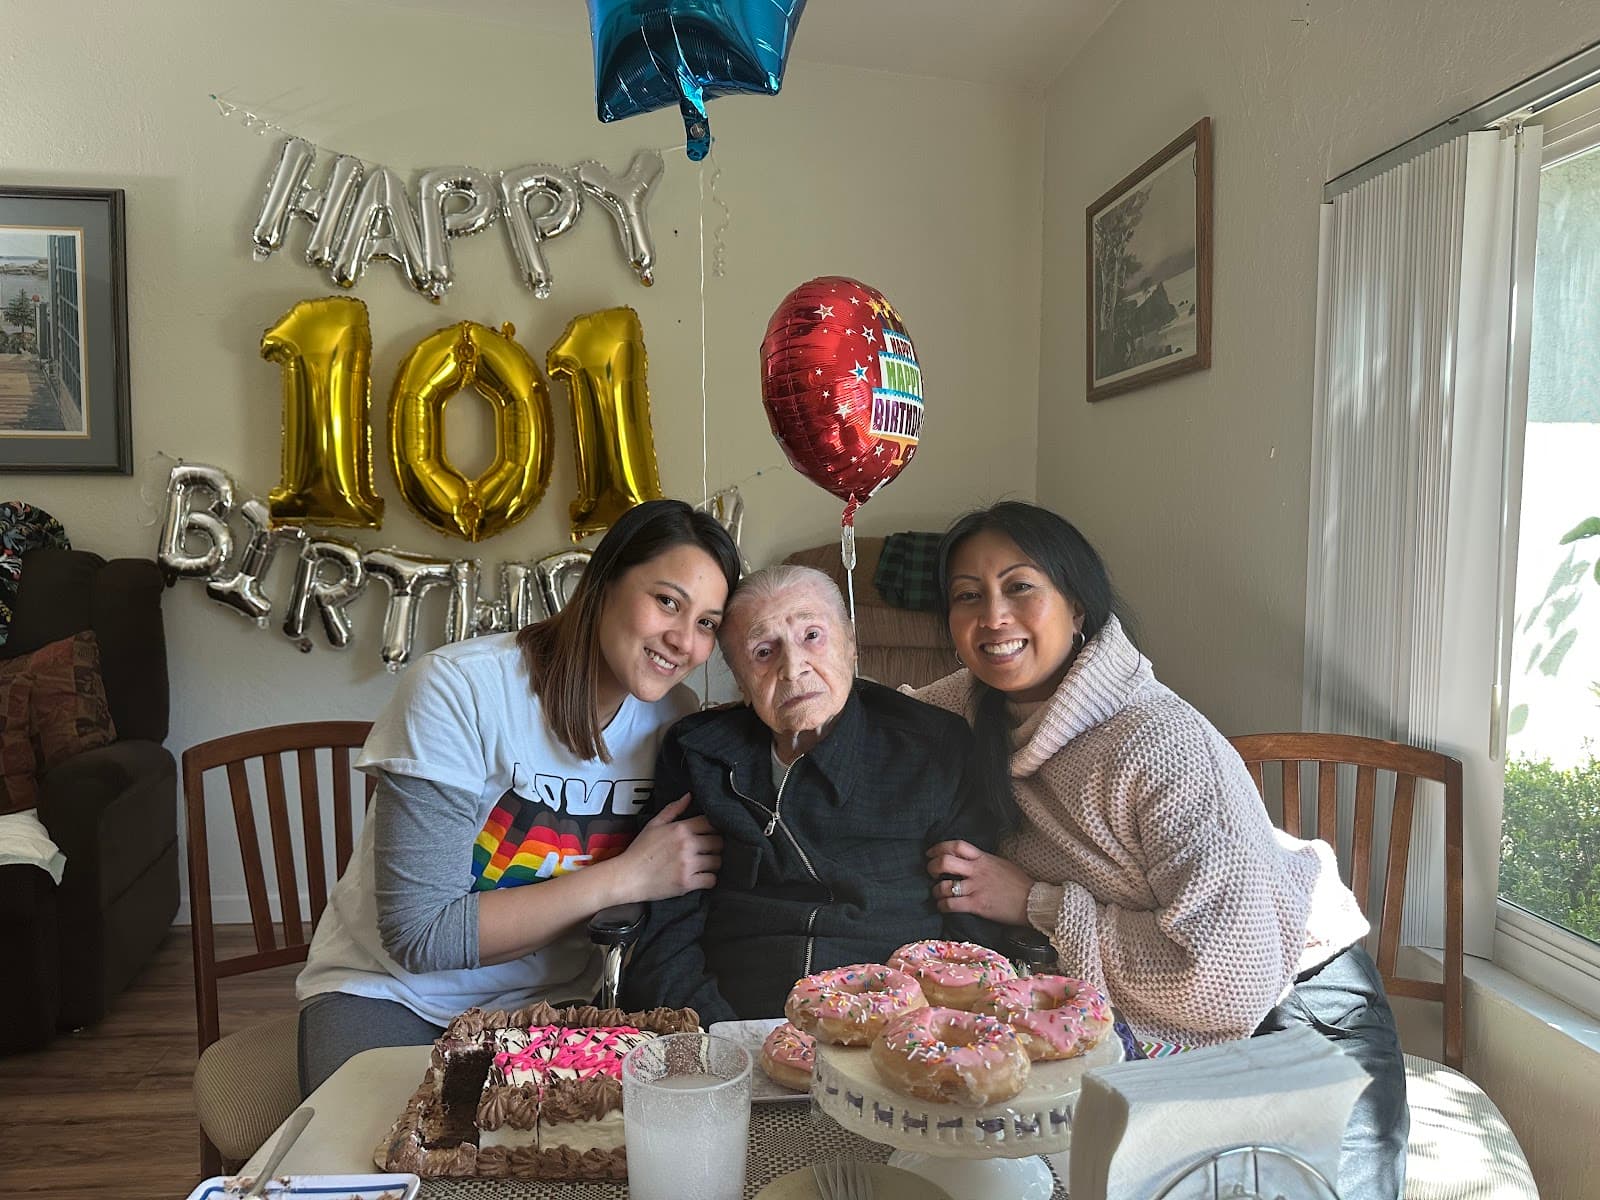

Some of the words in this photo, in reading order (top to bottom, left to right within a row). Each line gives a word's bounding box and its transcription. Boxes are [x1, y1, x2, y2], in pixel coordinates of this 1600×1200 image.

[252, 136, 665, 301] HAPPY
[886, 361, 919, 395] HAPPY
[260, 295, 665, 542] 101
[873, 398, 924, 437] BIRTHDA
[512, 762, 655, 816] LOVE
